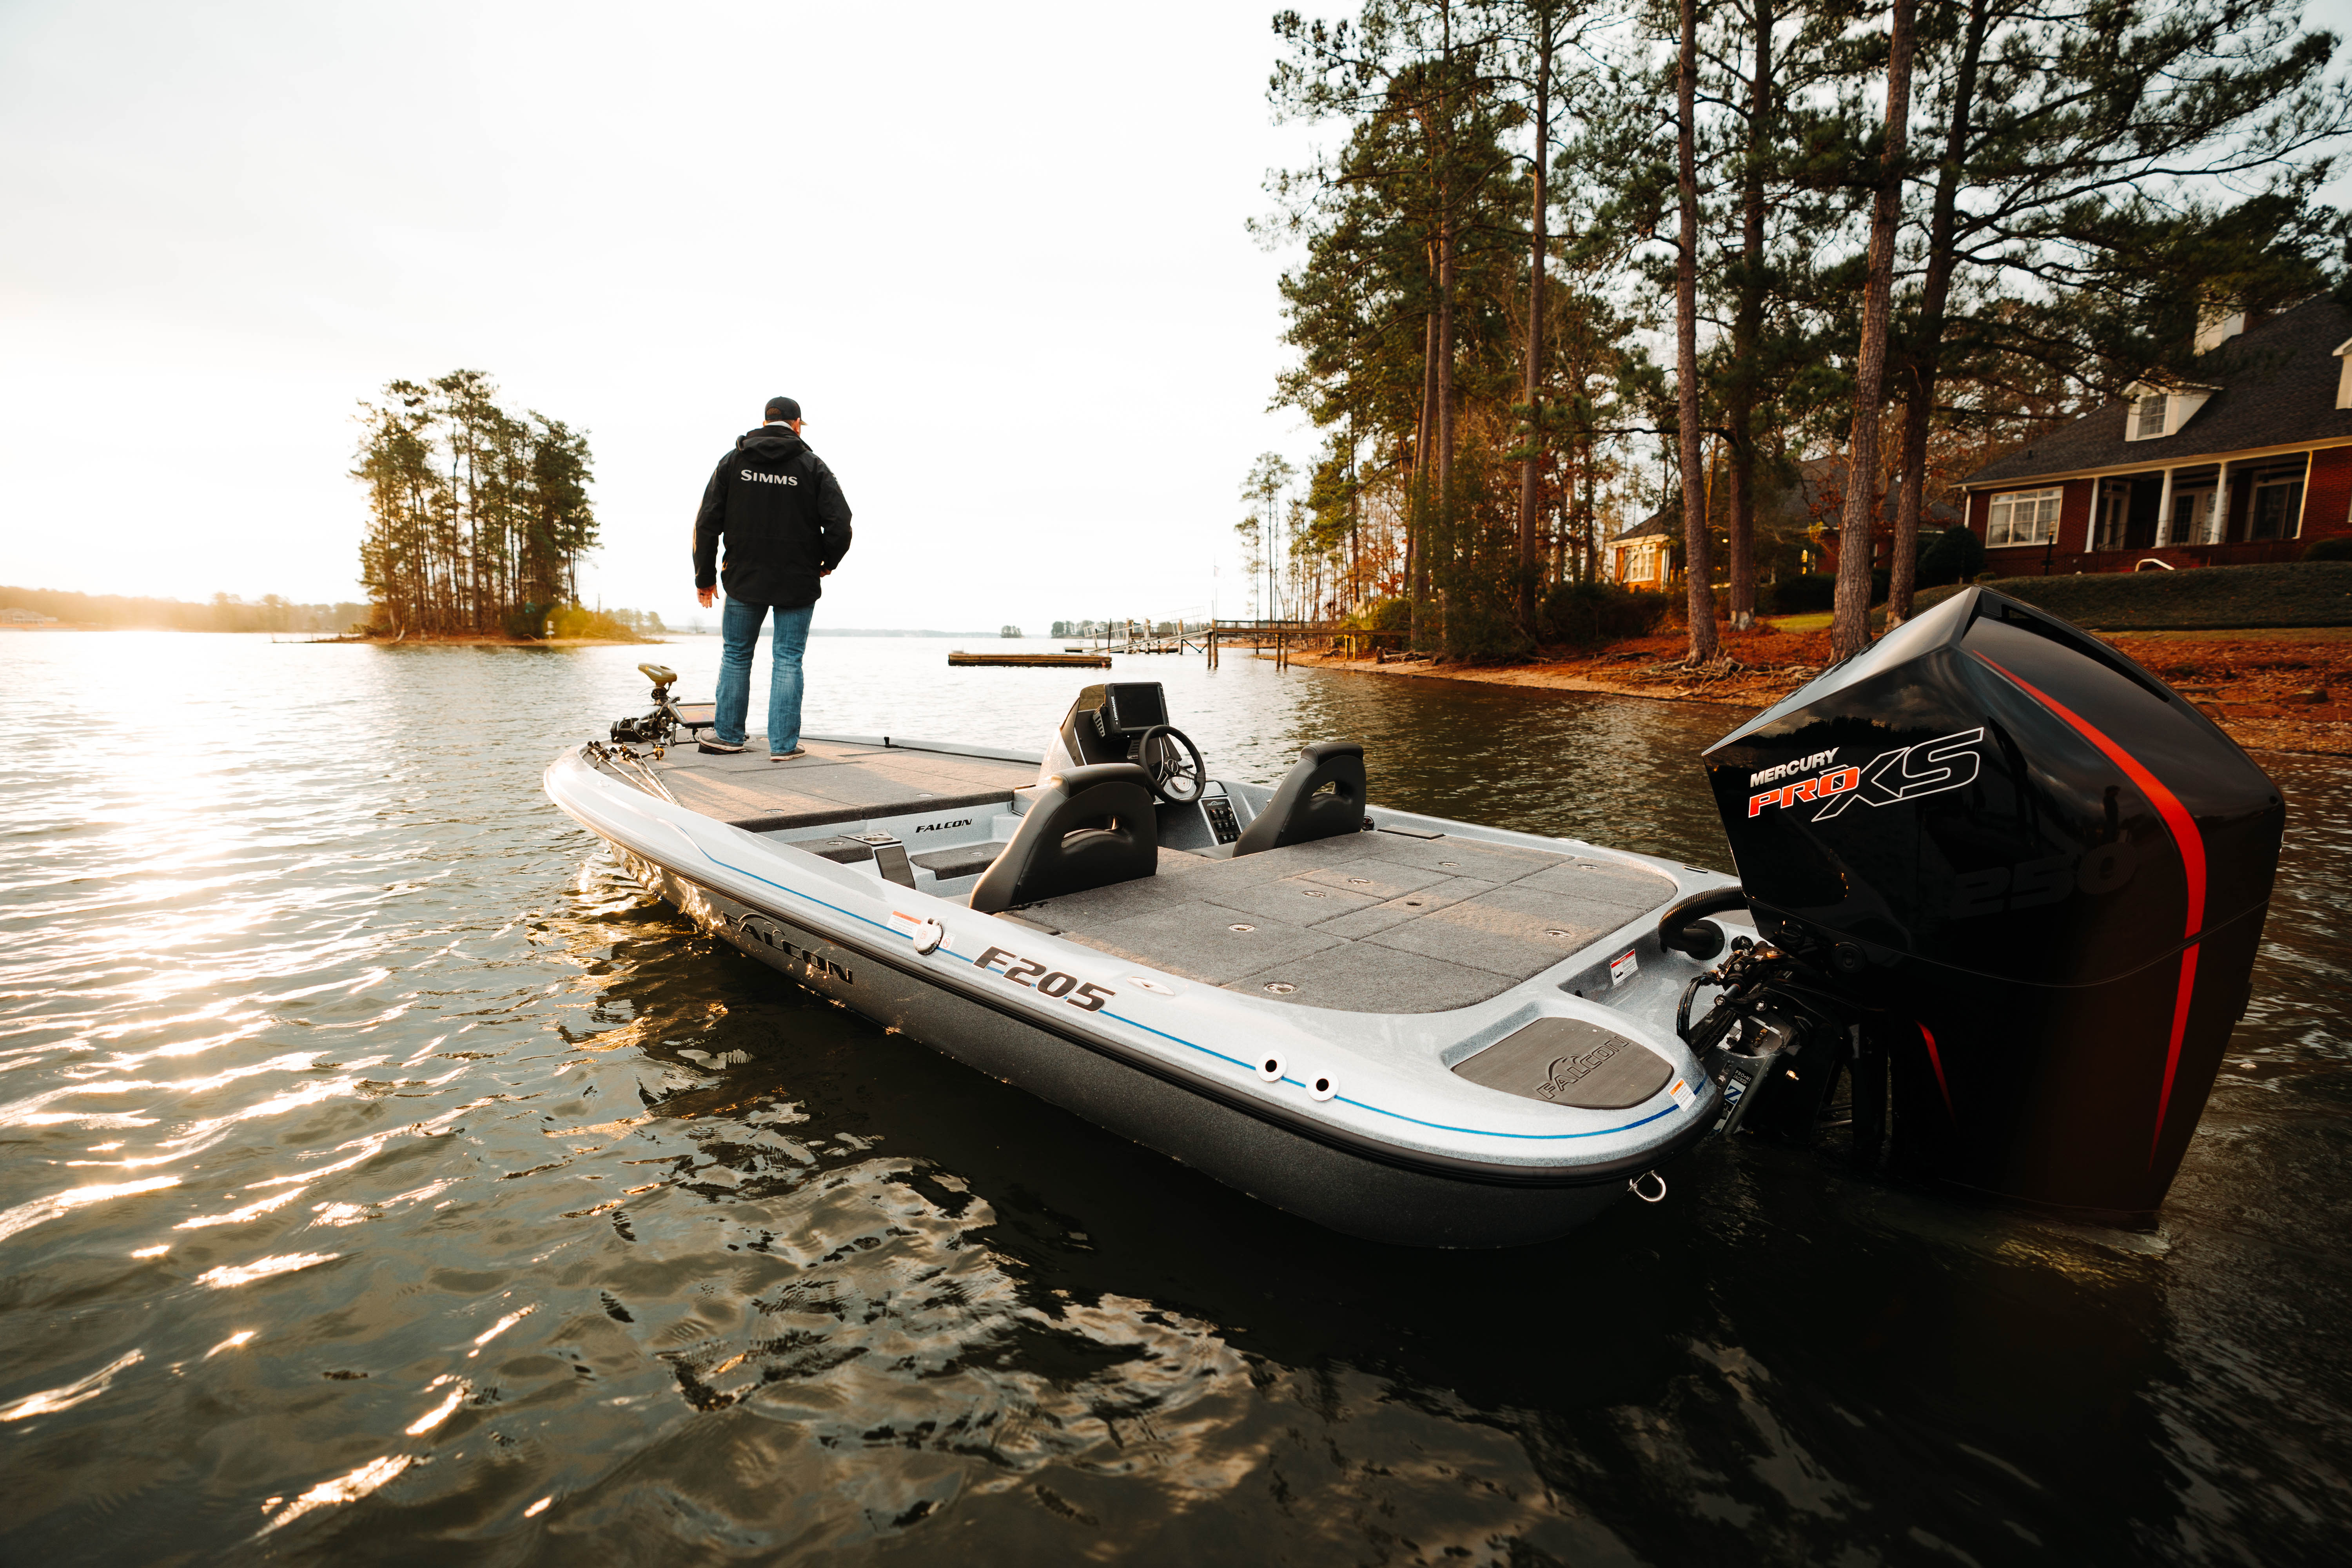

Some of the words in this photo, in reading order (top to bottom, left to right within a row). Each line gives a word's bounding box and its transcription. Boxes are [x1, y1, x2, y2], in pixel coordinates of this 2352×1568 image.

[740, 469, 798, 486] SIMMS
[1750, 747, 1839, 788] MERCURY
[1748, 766, 1860, 818] PRO
[915, 818, 972, 833] FALCON
[1949, 841, 2139, 920] 250
[972, 946, 1117, 1013] F205
[1536, 1036, 1630, 1100] FALCON
[1733, 1074, 1748, 1085] JACKER
